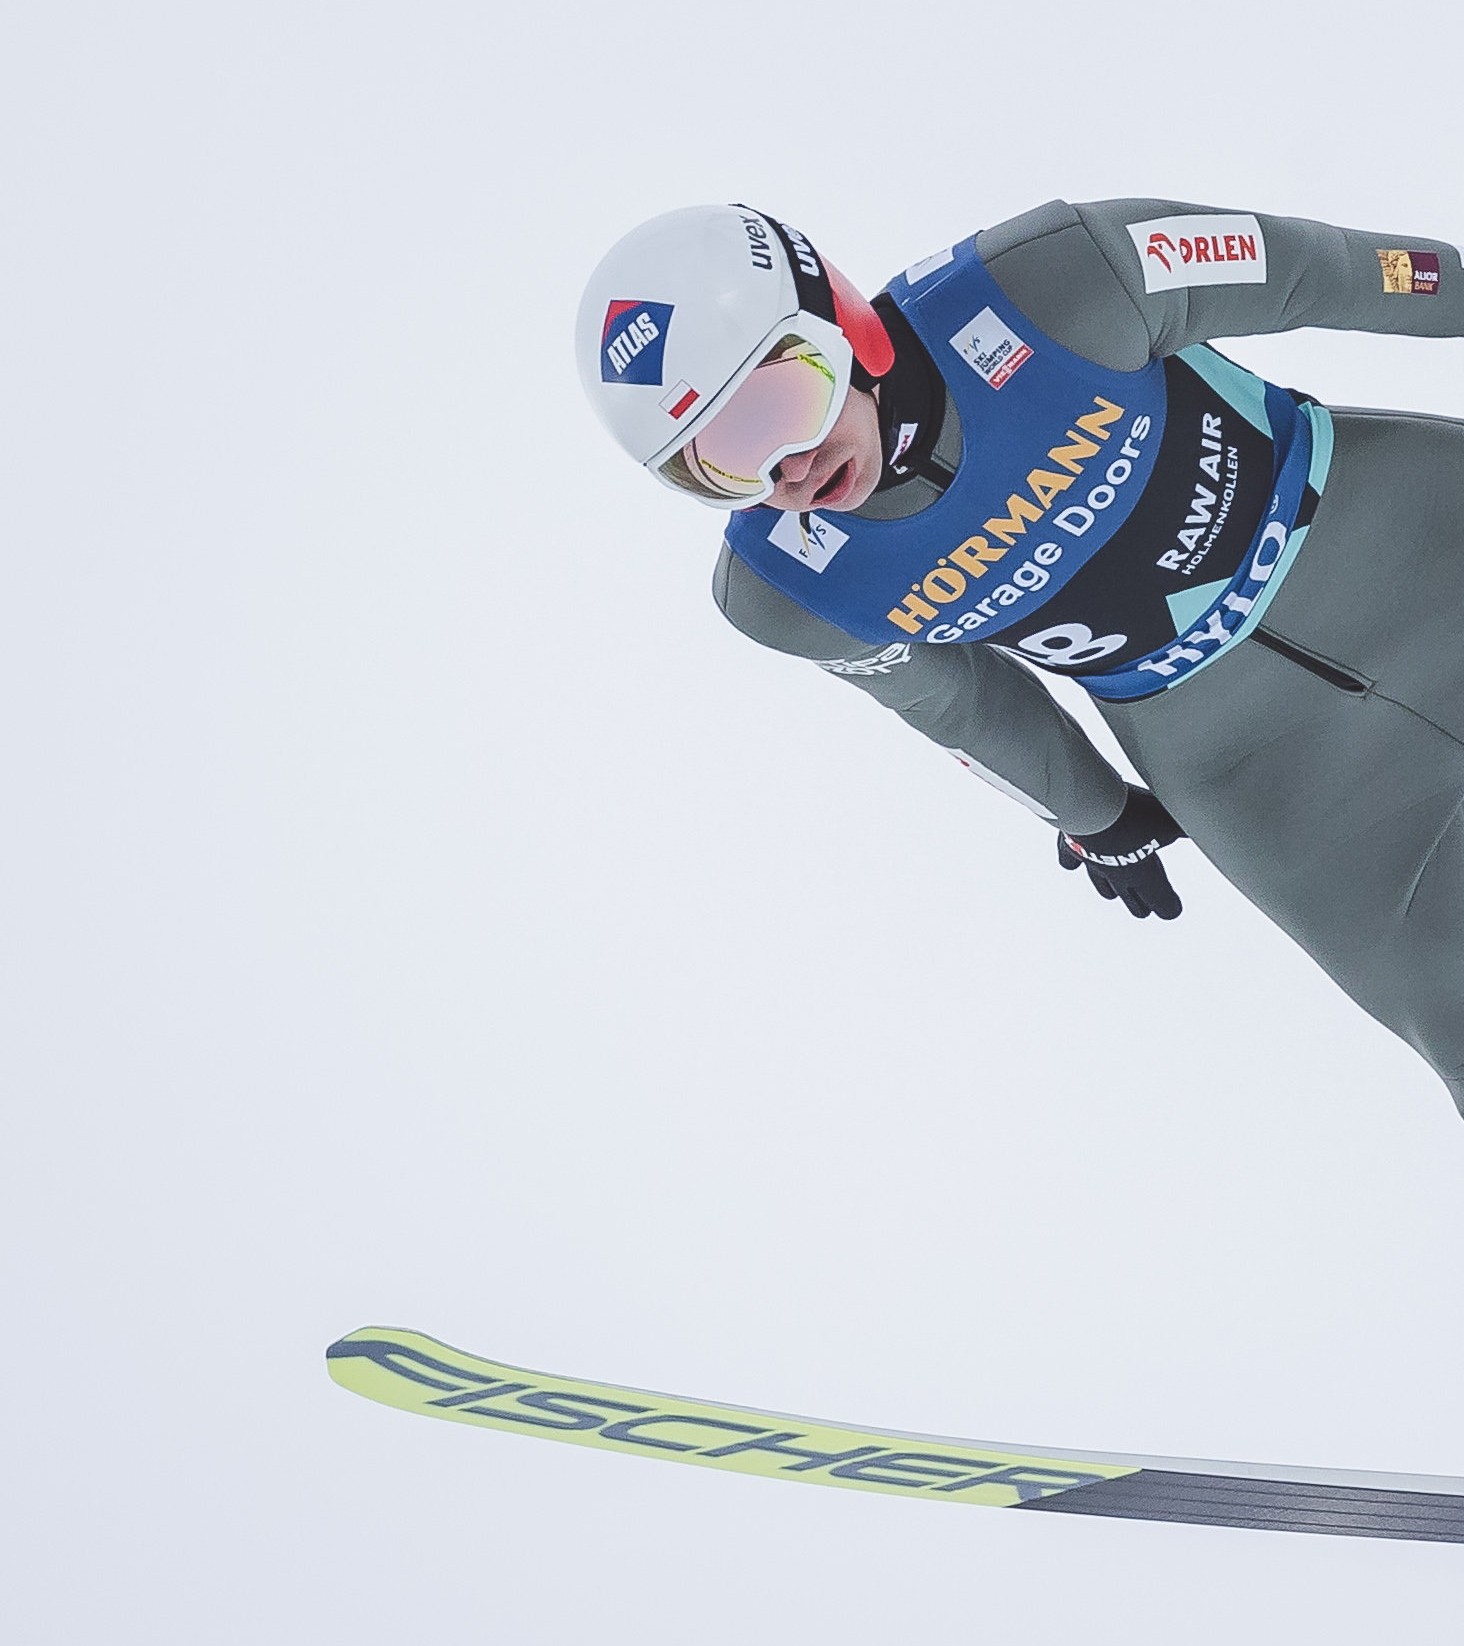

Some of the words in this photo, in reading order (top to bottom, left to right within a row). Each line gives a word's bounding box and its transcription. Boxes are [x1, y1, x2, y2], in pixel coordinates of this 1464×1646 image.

[739, 214, 773, 271] uvex
[781, 223, 820, 277] uve
[1179, 234, 1257, 264] ORLEN
[1414, 281, 1435, 292] BANK
[607, 312, 660, 376] ATLAS
[973, 352, 987, 366] SKI
[979, 339, 1012, 371] JUMPING
[985, 355, 1004, 376] WORLD
[886, 396, 1125, 635] HÖRMANN
[1156, 483, 1217, 571] RAW
[1200, 412, 1222, 483] AIR
[1181, 445, 1238, 575] HOLMENKOLLEN
[926, 542, 1063, 644] Garage
[1053, 414, 1151, 537] Doors
[326, 1340, 1106, 1501] FISCHER
